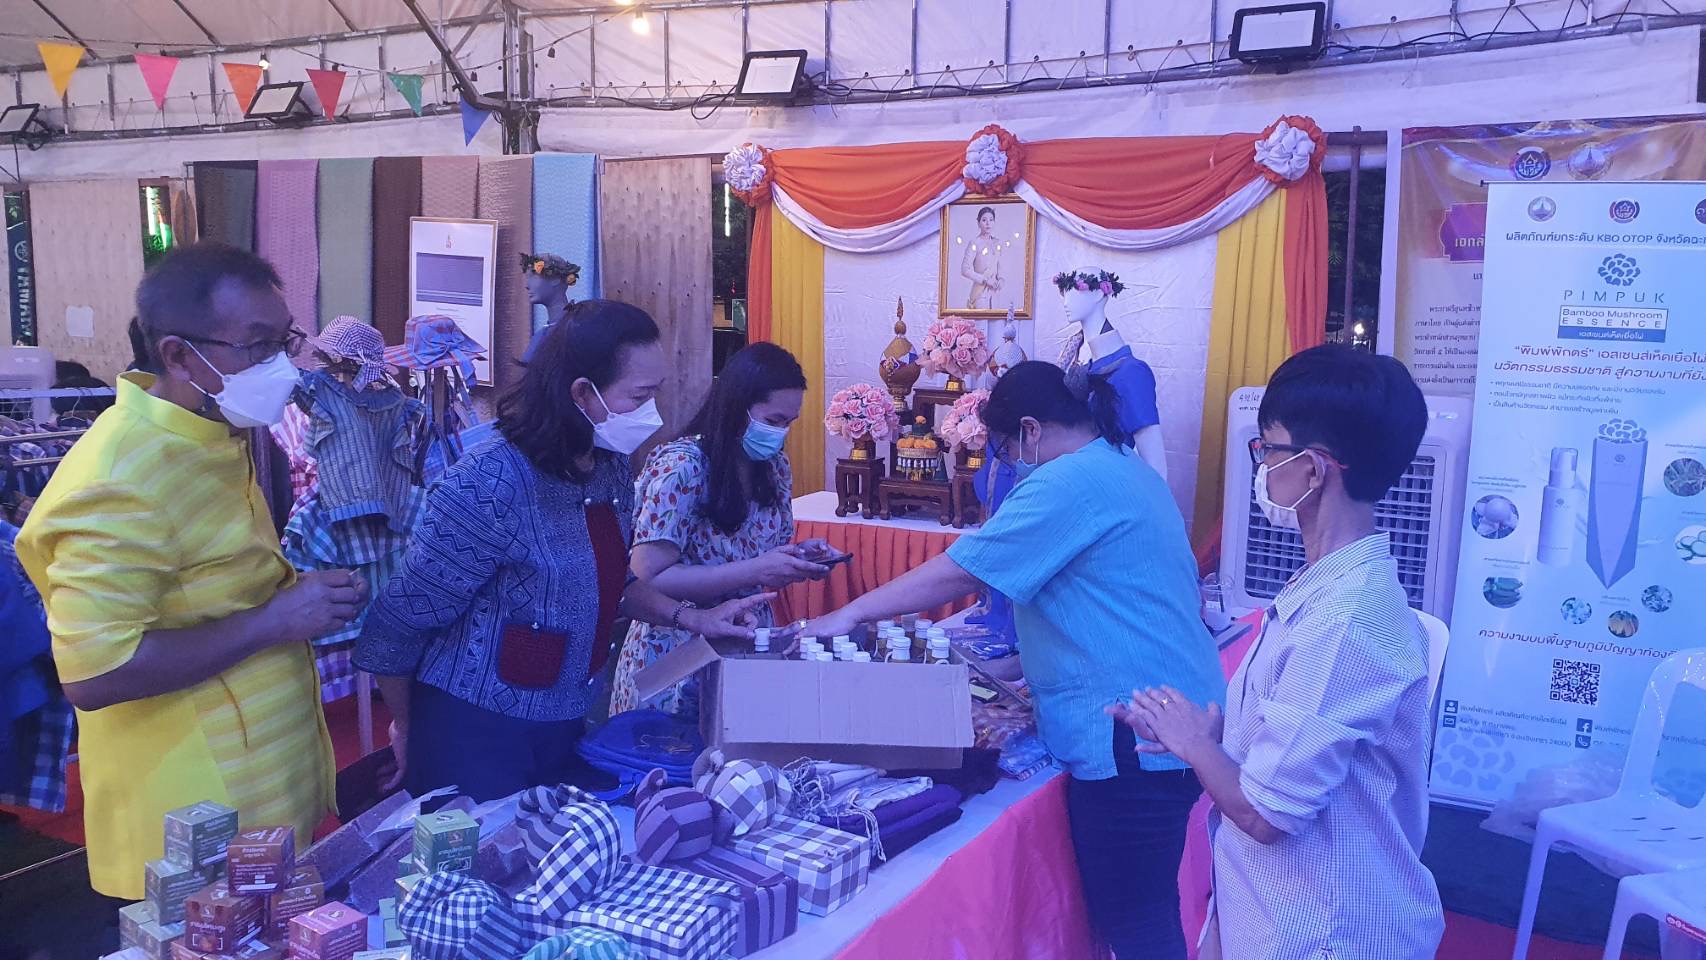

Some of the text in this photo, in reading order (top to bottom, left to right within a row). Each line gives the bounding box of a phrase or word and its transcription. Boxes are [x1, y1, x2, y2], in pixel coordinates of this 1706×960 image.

[1597, 234, 1620, 243] KBO
[1622, 235, 1653, 244] OTOP
[1564, 289, 1665, 304] PIMPUK
[1562, 308, 1663, 319] Bamboo Mushroom
[1561, 317, 1662, 328] ESSENCE
[1494, 360, 1612, 376] นวัตกรรมธรรมชาติ
